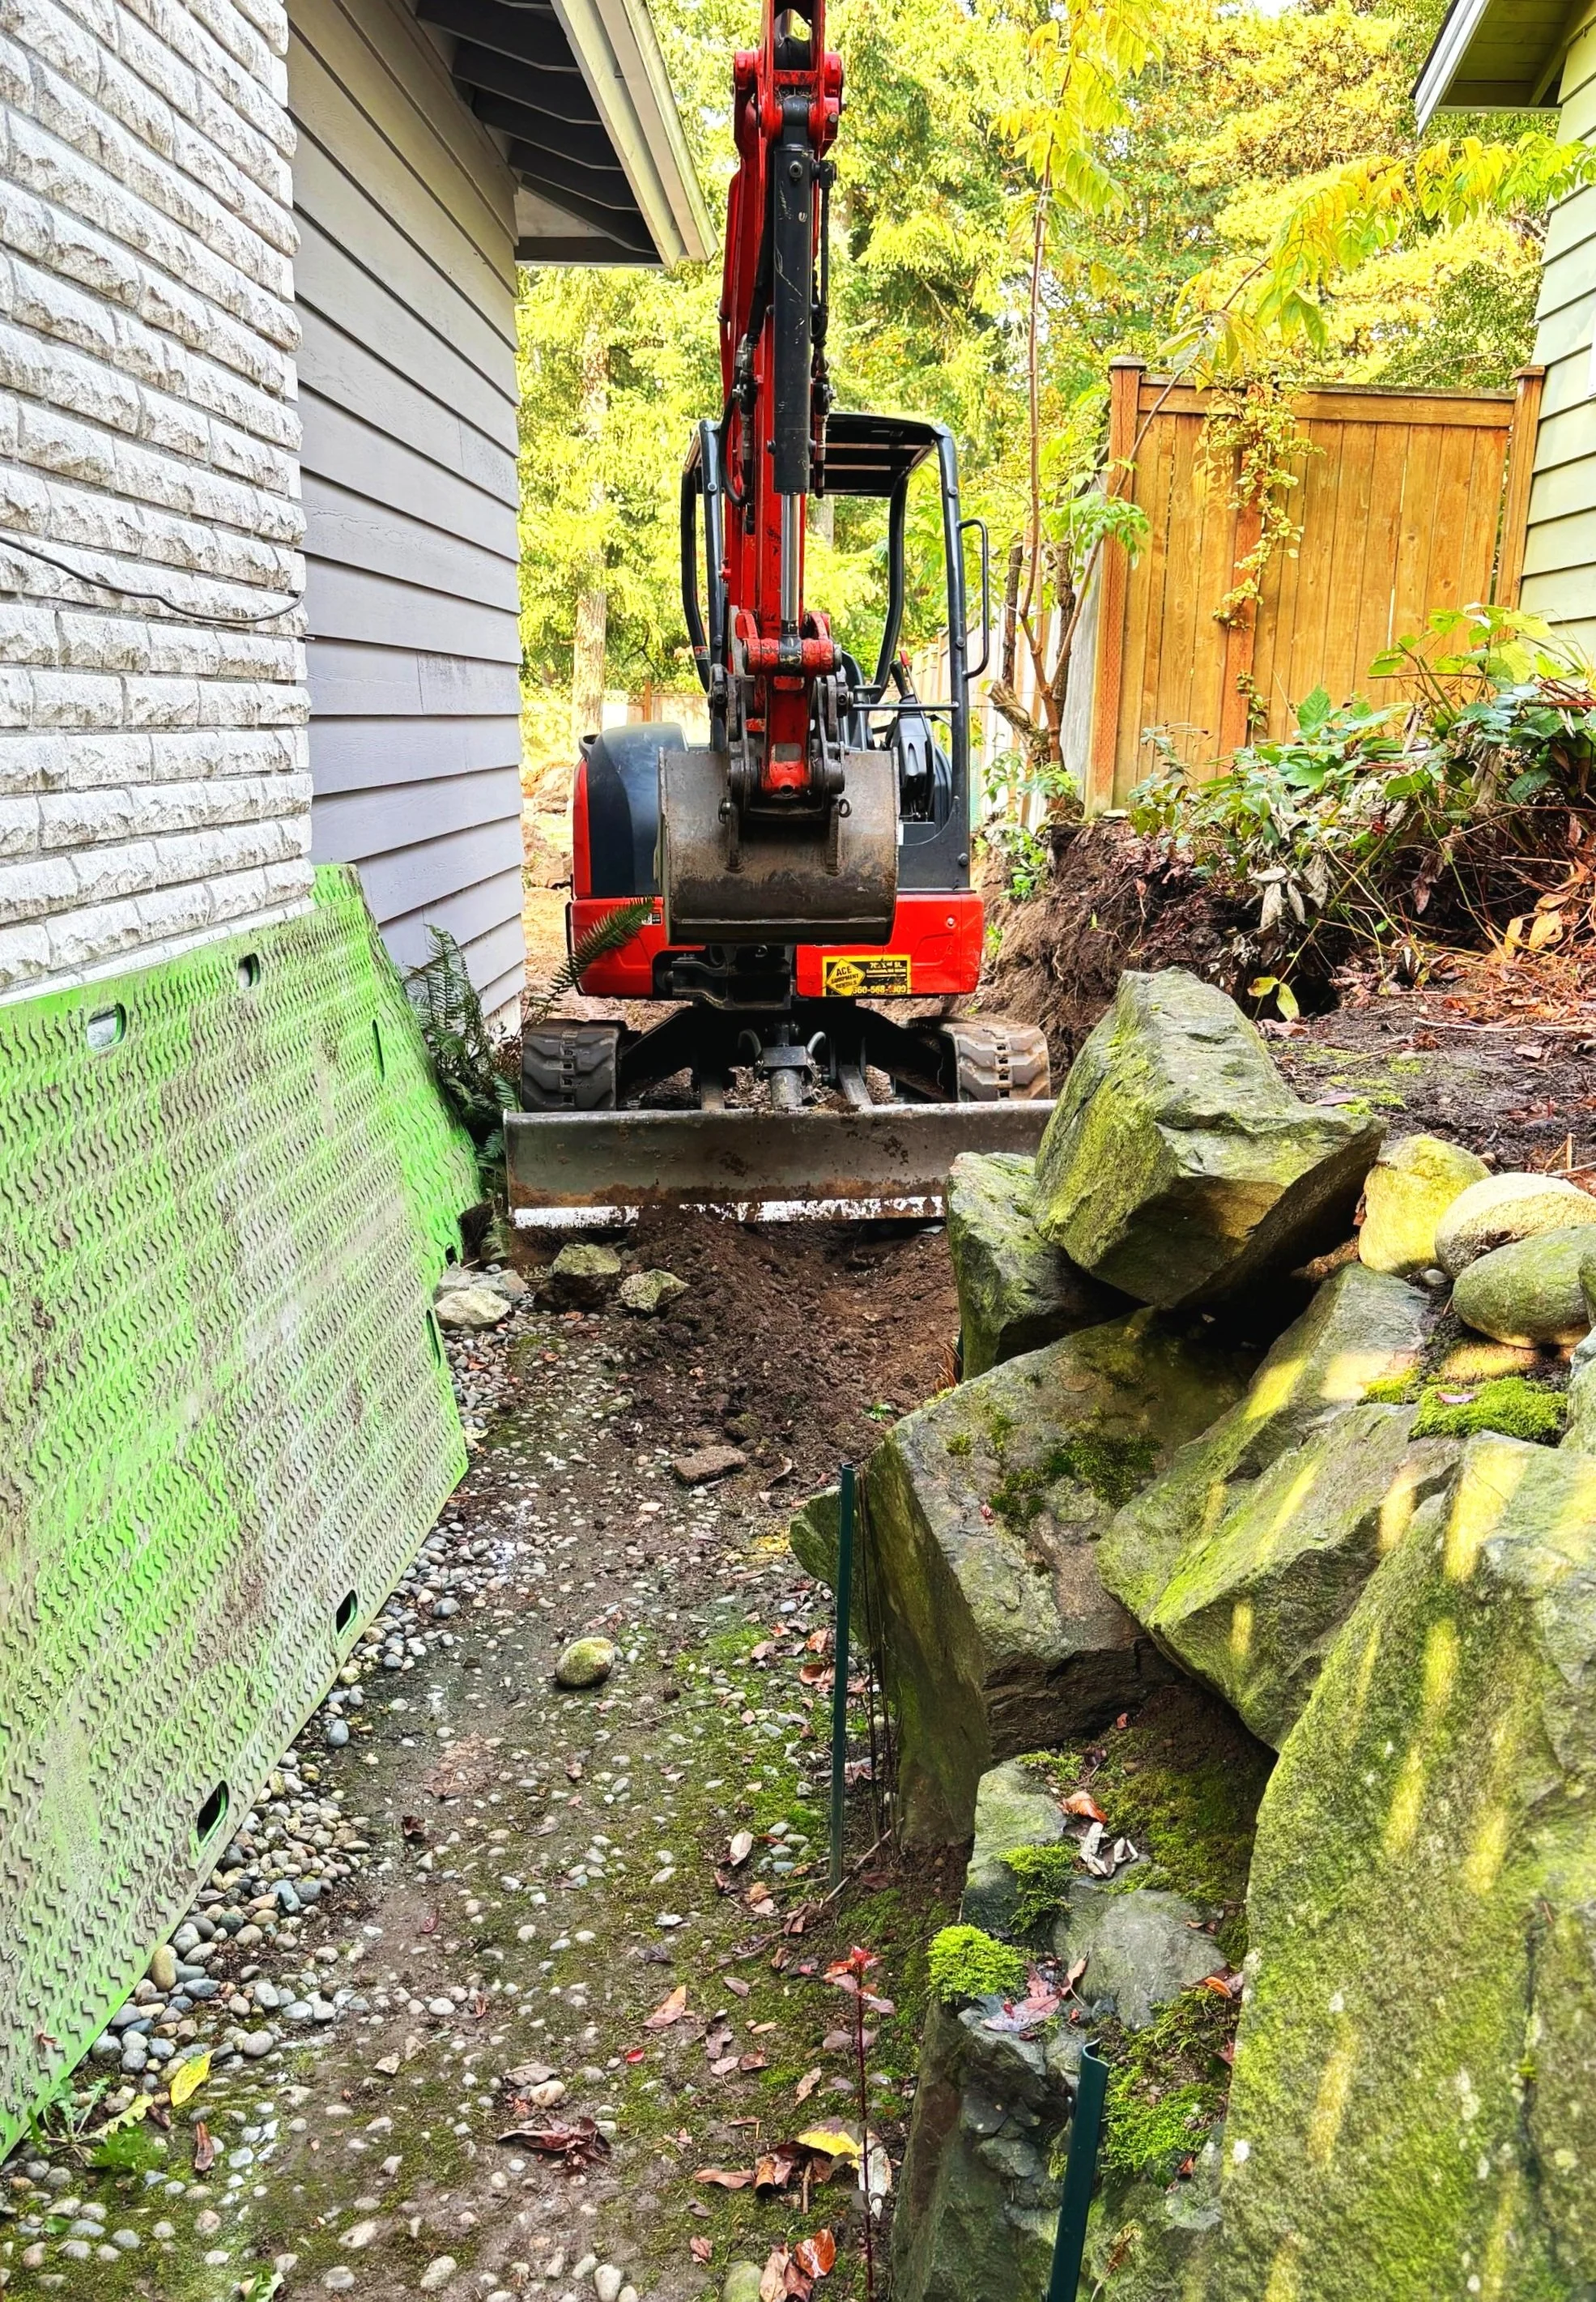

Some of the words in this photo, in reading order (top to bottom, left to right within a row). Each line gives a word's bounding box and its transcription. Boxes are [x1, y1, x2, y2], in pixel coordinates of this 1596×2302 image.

[836, 966, 852, 976] ACE
[831, 974, 859, 984] EQUIPMENT
[835, 980, 857, 989] RENTALS
